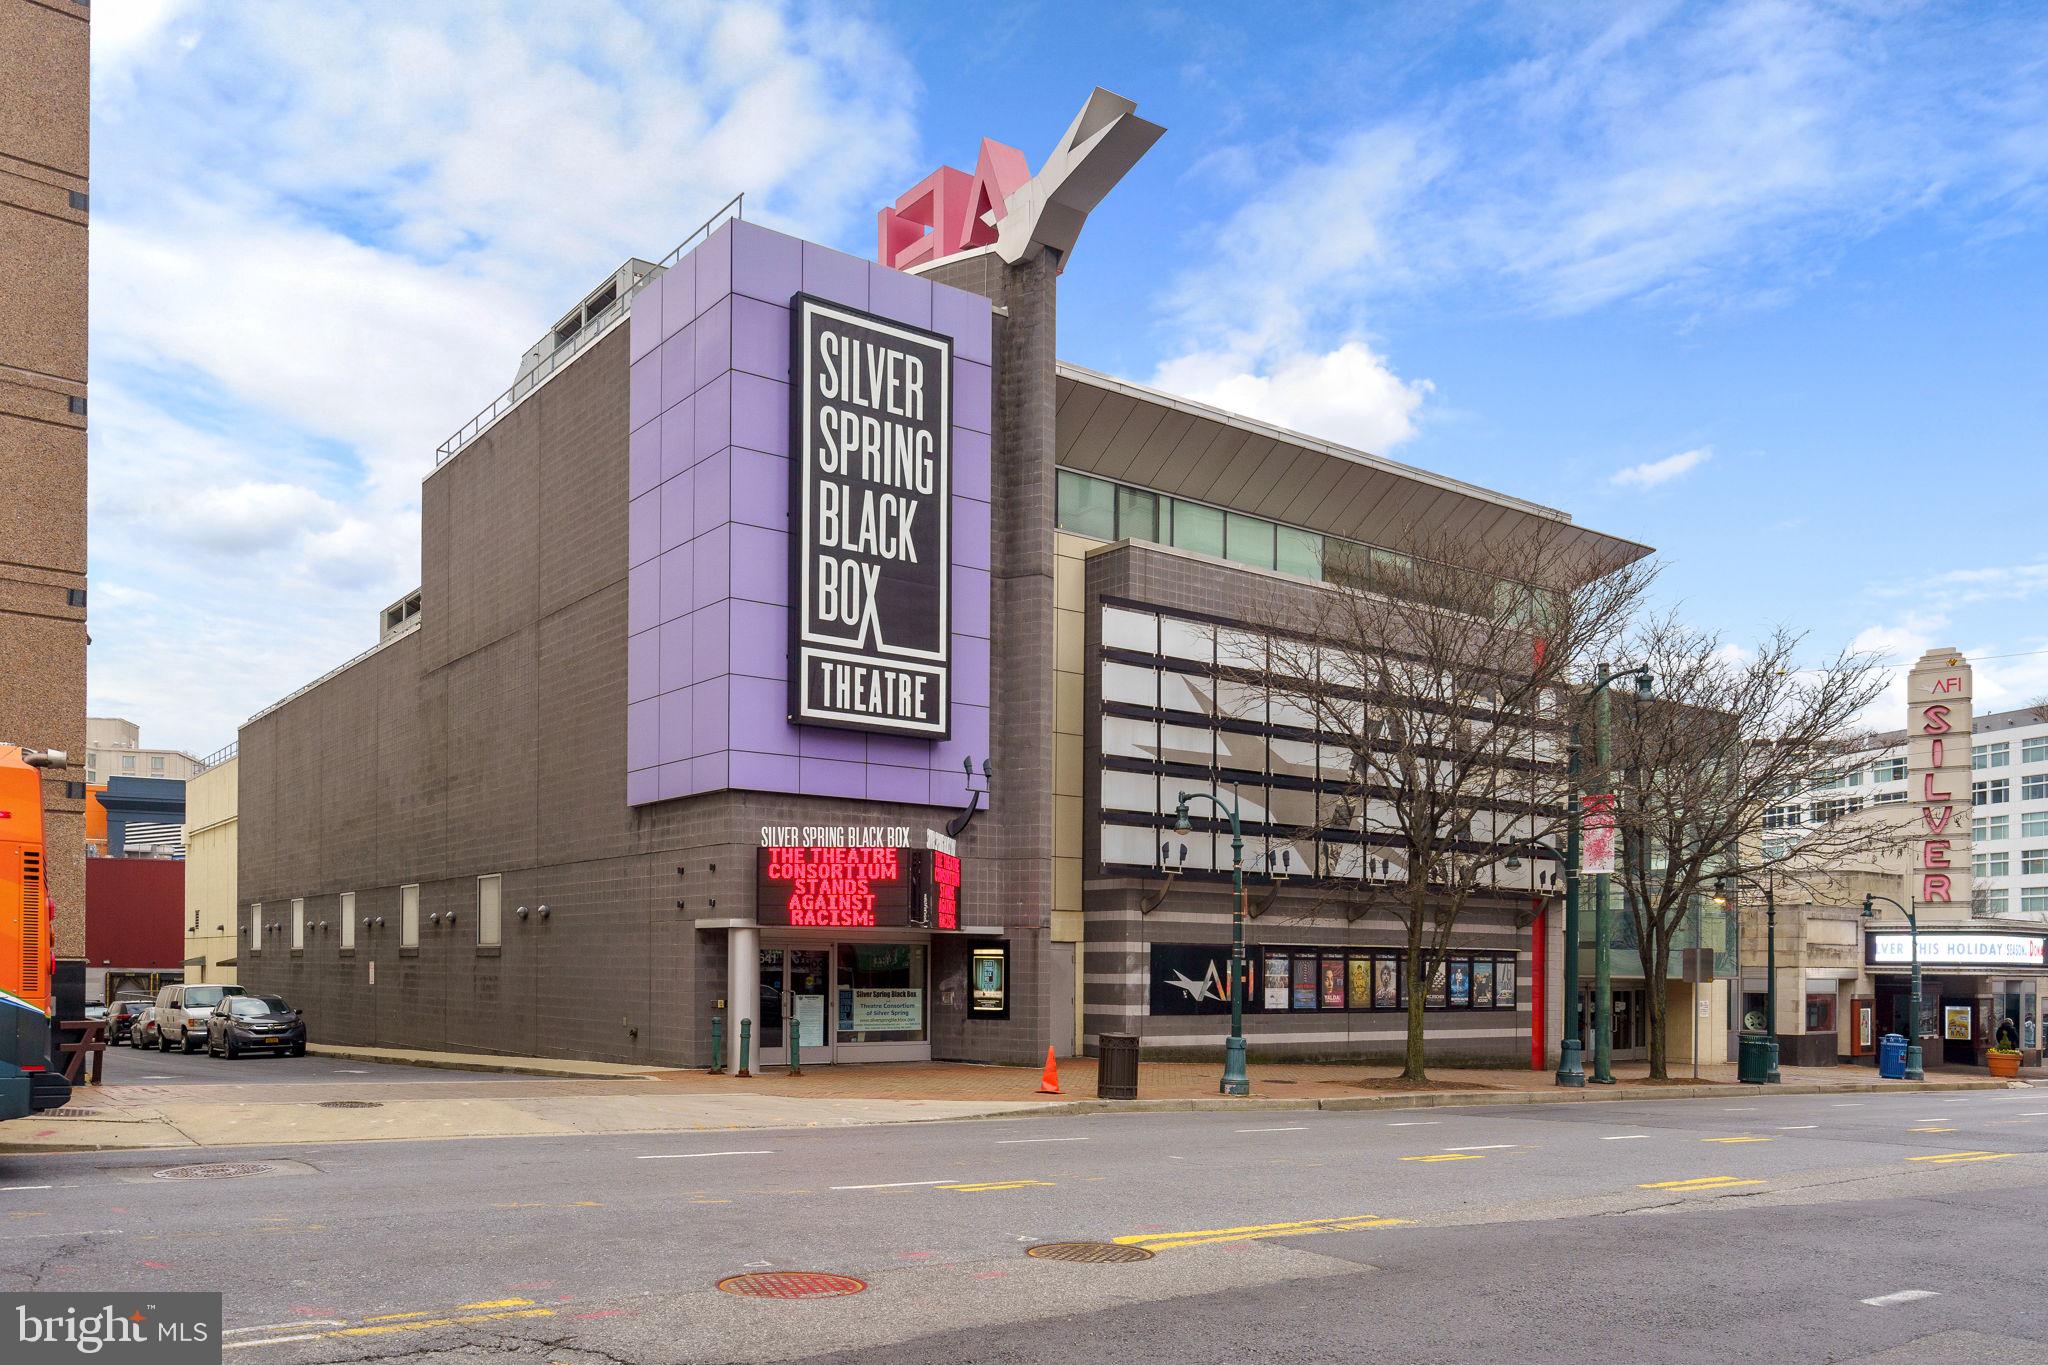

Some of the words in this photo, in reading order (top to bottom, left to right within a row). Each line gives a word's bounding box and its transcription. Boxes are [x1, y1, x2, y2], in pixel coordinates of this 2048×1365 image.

[818, 330, 924, 421] SILVER
[818, 405, 934, 495] SPRING
[818, 479, 918, 564] BLACK
[818, 554, 884, 649] BOX
[821, 661, 927, 719] THEATRE
[1931, 677, 1962, 694] AFI
[1922, 704, 1952, 902] SILVER
[761, 826, 799, 847] SILVER
[802, 826, 844, 847] SPRING
[848, 826, 884, 847] BLACK
[887, 826, 910, 848] BOX
[769, 847, 805, 864] THE
[810, 847, 897, 864] THEATRE
[768, 863, 897, 880] CONSORTIUM
[795, 879, 869, 895] STANDS
[789, 894, 876, 910] AGAINST
[790, 909, 875, 926] RACISM:
[1947, 943, 2003, 956] HOLIDAY
[873, 990, 891, 999] Spring
[907, 990, 917, 998] Box
